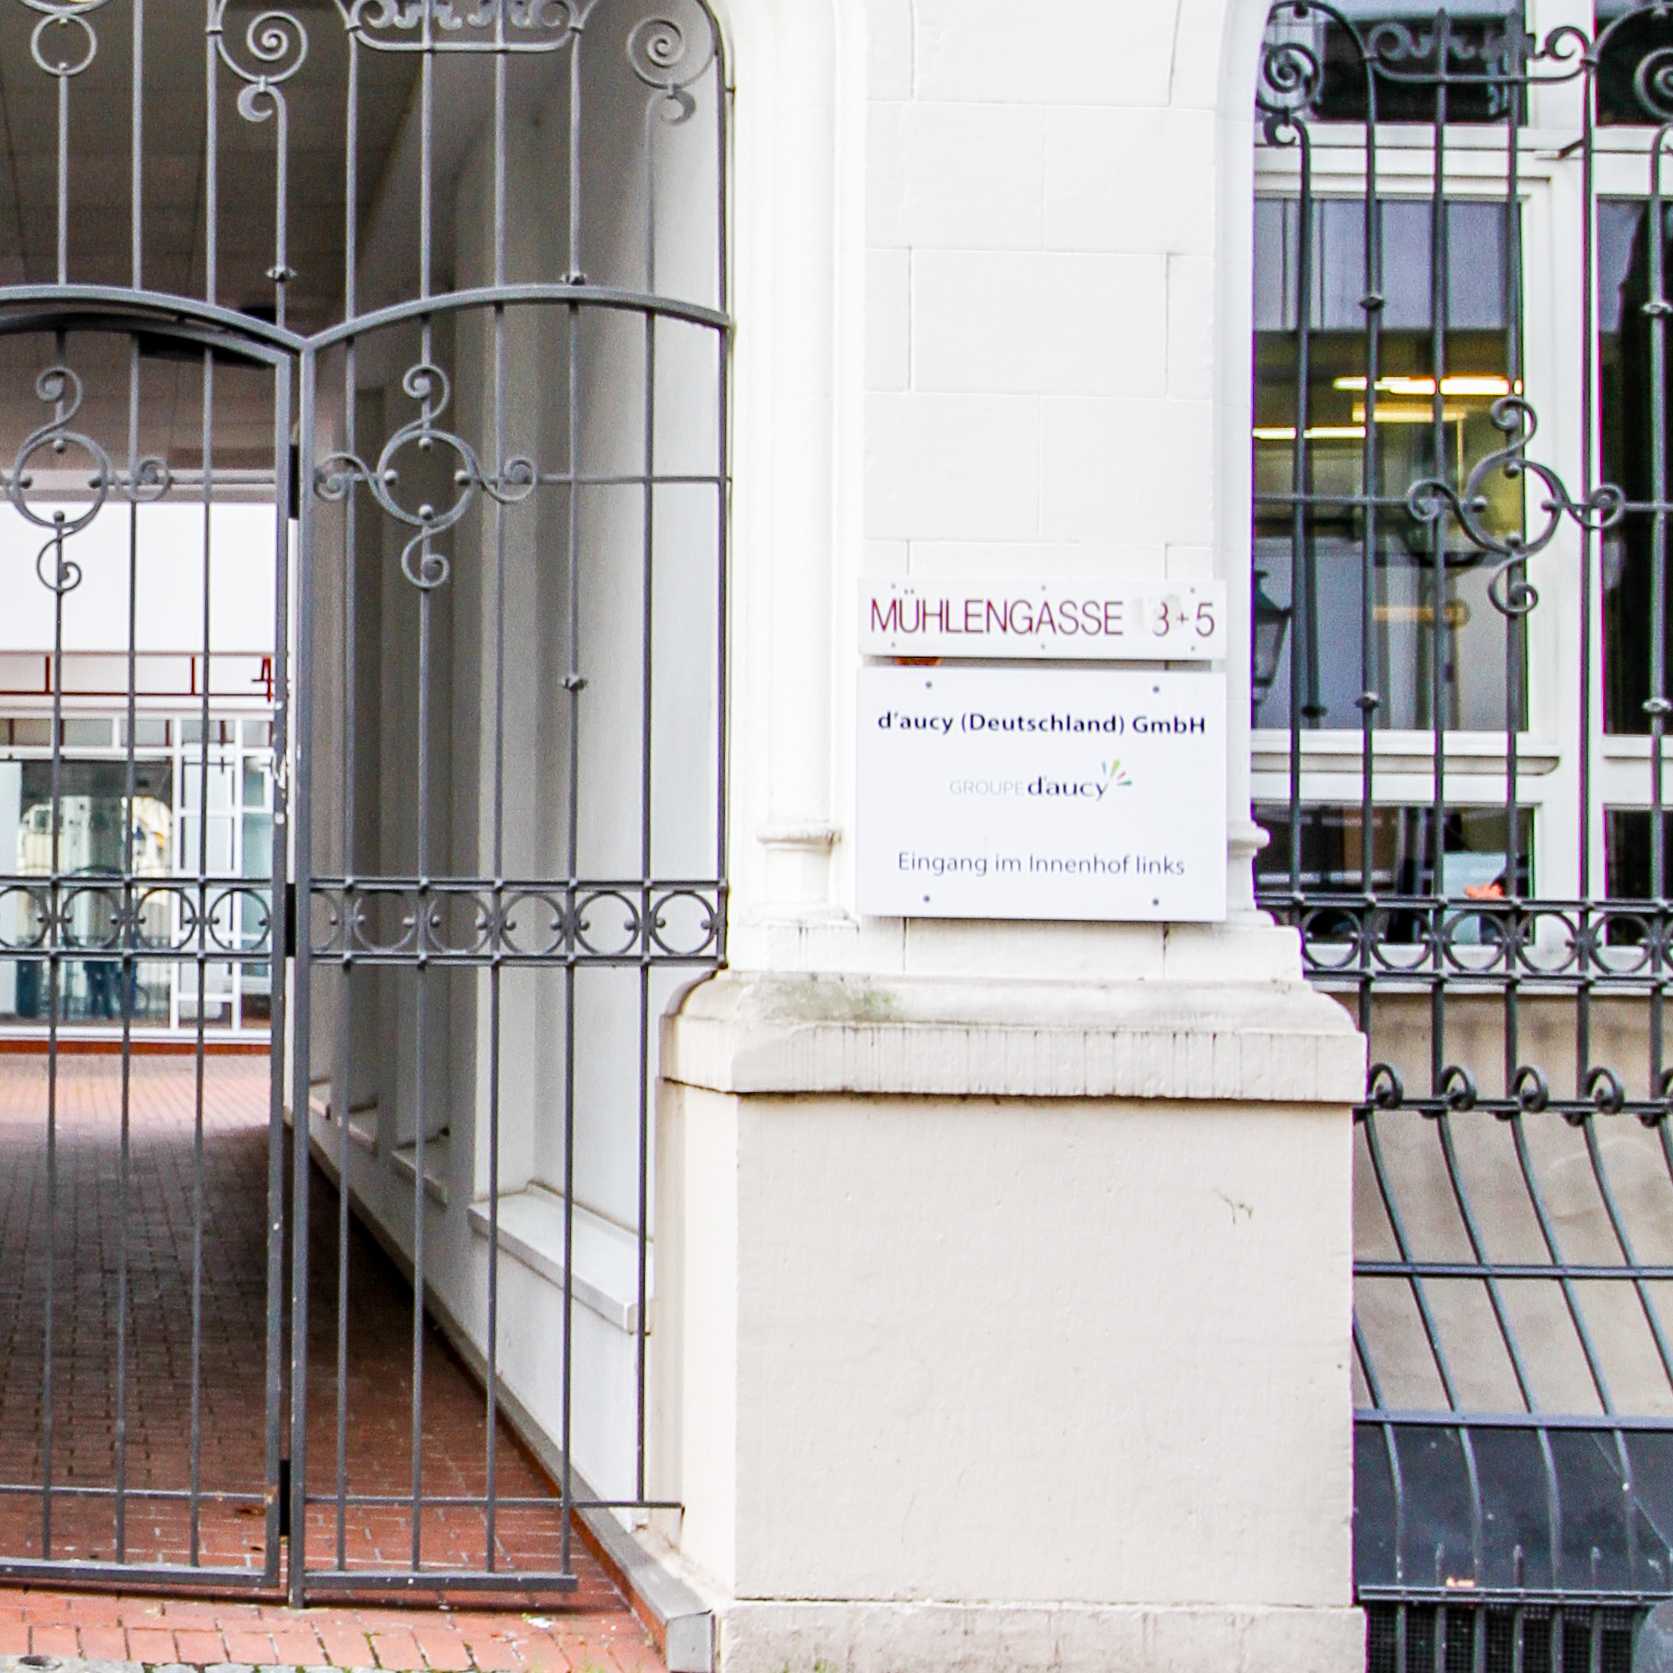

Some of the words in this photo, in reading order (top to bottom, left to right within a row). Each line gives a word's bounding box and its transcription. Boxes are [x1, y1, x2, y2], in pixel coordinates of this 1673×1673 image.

[870, 588, 1124, 636] MÜHLENGASSE
[877, 710, 954, 735] d'aucy
[960, 711, 1125, 735] (Deutschland)
[1131, 714, 1206, 734] GmbH
[949, 779, 1025, 796] GROUPE
[898, 850, 987, 877] Eingang
[995, 854, 1022, 872] im
[1029, 853, 1130, 874] Innenhof
[1136, 855, 1185, 876] links
